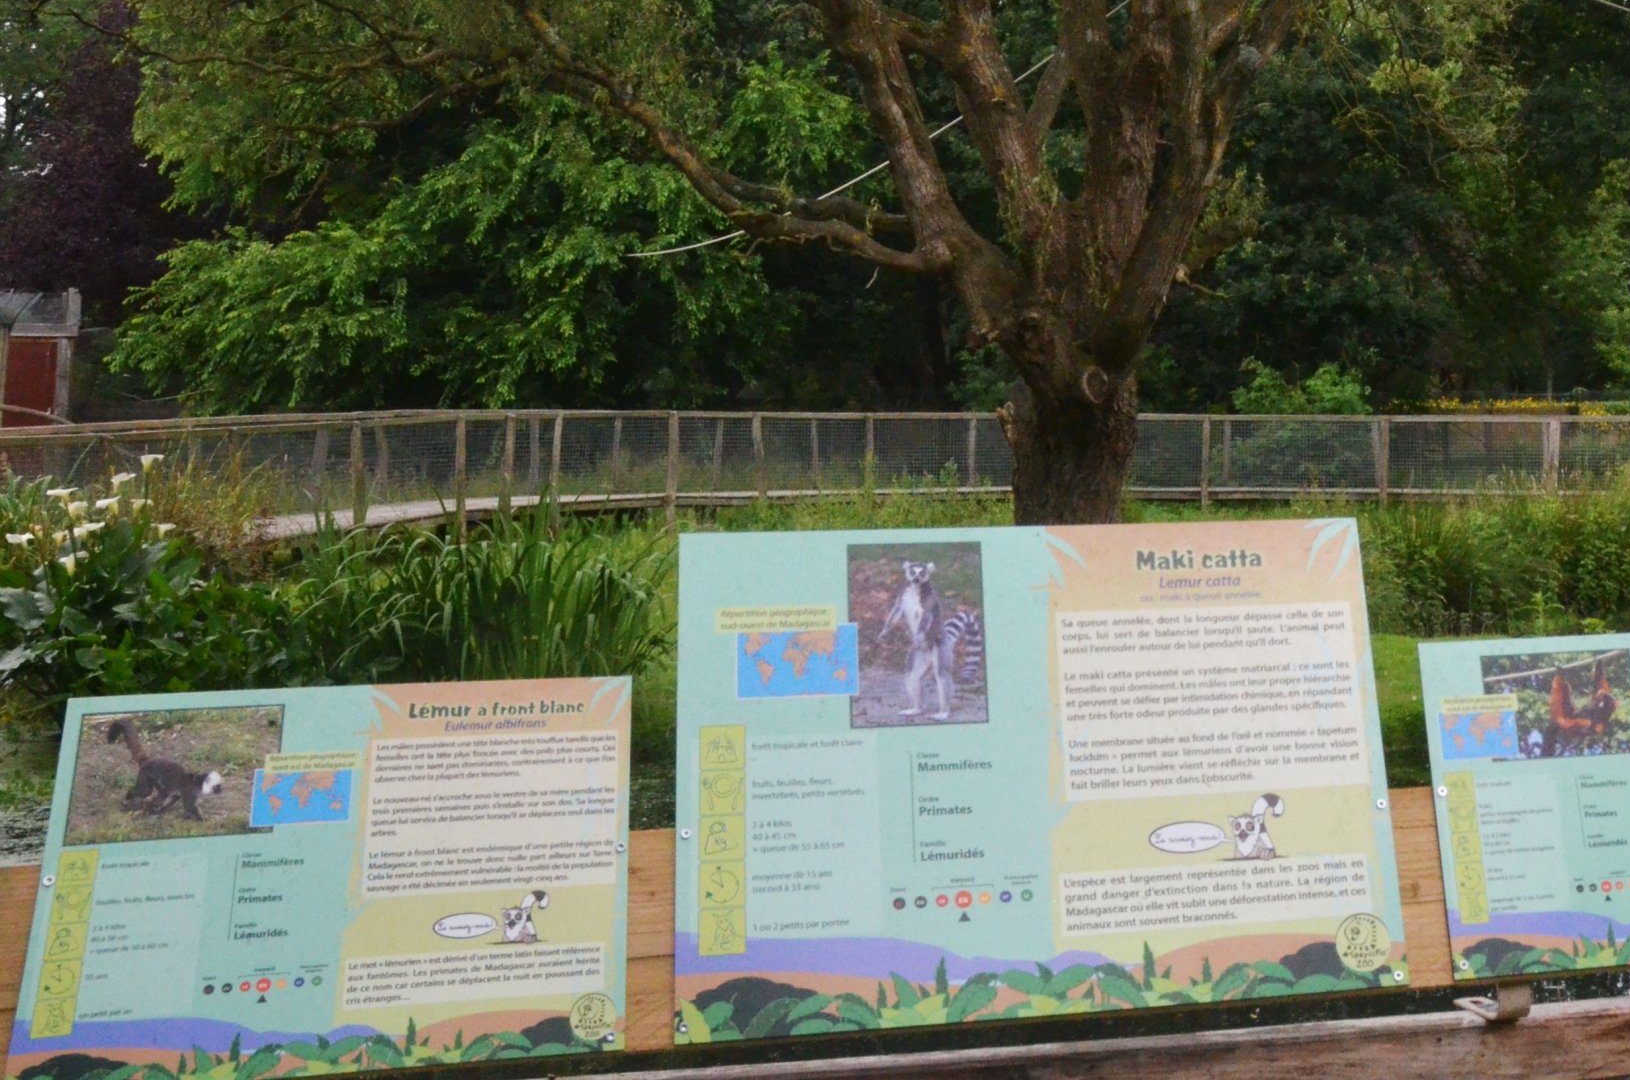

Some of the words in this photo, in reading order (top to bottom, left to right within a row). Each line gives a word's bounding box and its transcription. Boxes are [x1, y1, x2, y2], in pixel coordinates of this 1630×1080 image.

[1136, 550, 1194, 570] Maki
[1202, 549, 1262, 568] catta
[1158, 577, 1202, 589] Lemur
[1206, 576, 1241, 588] catta
[1064, 672, 1076, 681] Le
[1078, 670, 1104, 681] maki
[1106, 669, 1132, 680] catta
[1134, 667, 1179, 681] présente
[1181, 668, 1195, 676] un
[1196, 664, 1238, 678] système
[1240, 661, 1290, 673] matriarcal
[1298, 663, 1309, 671] ce
[1311, 660, 1333, 671] sont
[1335, 659, 1350, 669] les
[1065, 683, 1107, 694] femelles
[1108, 682, 1126, 695] qui
[1126, 680, 1176, 692] dominent.
[1179, 679, 1196, 689] Les
[1197, 677, 1227, 688] mâles
[1228, 677, 1246, 687] ont
[1247, 676, 1266, 686] leur
[1268, 676, 1301, 687] propre
[1302, 671, 1351, 683] hiérarchie
[1066, 698, 1076, 708] et
[1077, 696, 1118, 709] peuvent
[1119, 697, 1130, 705] se
[1132, 693, 1160, 705] défier
[1162, 695, 1178, 705] par
[1180, 690, 1238, 702] intimidation
[1240, 688, 1286, 701] chimique,
[1287, 689, 1300, 698] en
[1302, 685, 1353, 699] répandant
[492, 702, 535, 716] front
[540, 700, 584, 714] blanc
[1066, 713, 1086, 721] une
[1087, 709, 1107, 720] très
[1108, 709, 1134, 719] forte
[1135, 707, 1165, 718] odeur
[1166, 705, 1210, 719] produite
[1211, 706, 1228, 717] par
[1230, 703, 1248, 714] des
[1249, 701, 1288, 715] glandes
[1290, 699, 1346, 713] spécifiques.
[444, 720, 493, 732] Eulemur
[495, 719, 546, 729] albifrons
[1068, 739, 1089, 749] Une
[1090, 736, 1144, 747] membrane
[1145, 733, 1175, 745] située
[1177, 735, 1190, 743] au
[1191, 731, 1215, 742] fond
[1216, 731, 1229, 741] de
[1252, 730, 1262, 740] et
[1264, 727, 1307, 739] nommée
[1316, 726, 1357, 738] tapetum
[1069, 751, 1109, 762] lucidum
[1119, 748, 1158, 762] permet
[1160, 749, 1179, 758] aux
[1182, 745, 1232, 756] lémuriens
[1272, 743, 1291, 752] une
[1294, 740, 1326, 751] bonne
[1329, 738, 1358, 749] vision
[917, 760, 993, 772] Mammifères
[1070, 765, 1119, 776] nocturne.
[1121, 763, 1134, 773] La
[1136, 760, 1176, 772] lumière
[1178, 759, 1204, 770] vient
[1206, 760, 1218, 769] se
[1219, 756, 1261, 768] réfléchir
[1263, 757, 1279, 766] sur
[1281, 754, 1291, 765] la
[1293, 752, 1347, 764] membrane
[1349, 751, 1360, 761] et
[1070, 779, 1088, 790] fait
[1089, 778, 1120, 789] briller
[1122, 777, 1147, 788] leurs
[1149, 777, 1173, 788] yeux
[1175, 774, 1200, 785] dans
[918, 805, 973, 816] Primates
[1584, 809, 1618, 819] Primates
[241, 857, 304, 868] Mammifères
[920, 848, 985, 862] Lémuridés
[1109, 874, 1126, 885] est
[1129, 871, 1182, 886] largement
[1186, 865, 1247, 882] représentée
[1250, 865, 1275, 876] dans
[1278, 863, 1293, 874] les
[1296, 863, 1320, 873] zoos
[1322, 859, 1347, 871] mais
[1350, 860, 1364, 869] en
[1064, 889, 1098, 904] grand
[1100, 888, 1140, 900] danger
[1211, 881, 1239, 892] dans
[1254, 878, 1294, 889] nature.
[1296, 876, 1310, 886] La
[1312, 873, 1348, 887] région
[1350, 871, 1365, 883] de
[238, 894, 283, 904] Primates
[1065, 904, 1128, 917] Madagascar
[1144, 899, 1164, 911] elle
[1165, 898, 1179, 909] vit
[1180, 896, 1206, 908] subit
[1207, 897, 1227, 906] une
[1297, 889, 1336, 900] intense,
[1338, 887, 1348, 897] et
[1350, 887, 1366, 897] ces
[1066, 920, 1111, 932] animaux
[1113, 917, 1136, 928] sont
[1138, 914, 1180, 927] souvent
[1181, 910, 1237, 924] braconnés.
[233, 927, 289, 940] Lémuridés
